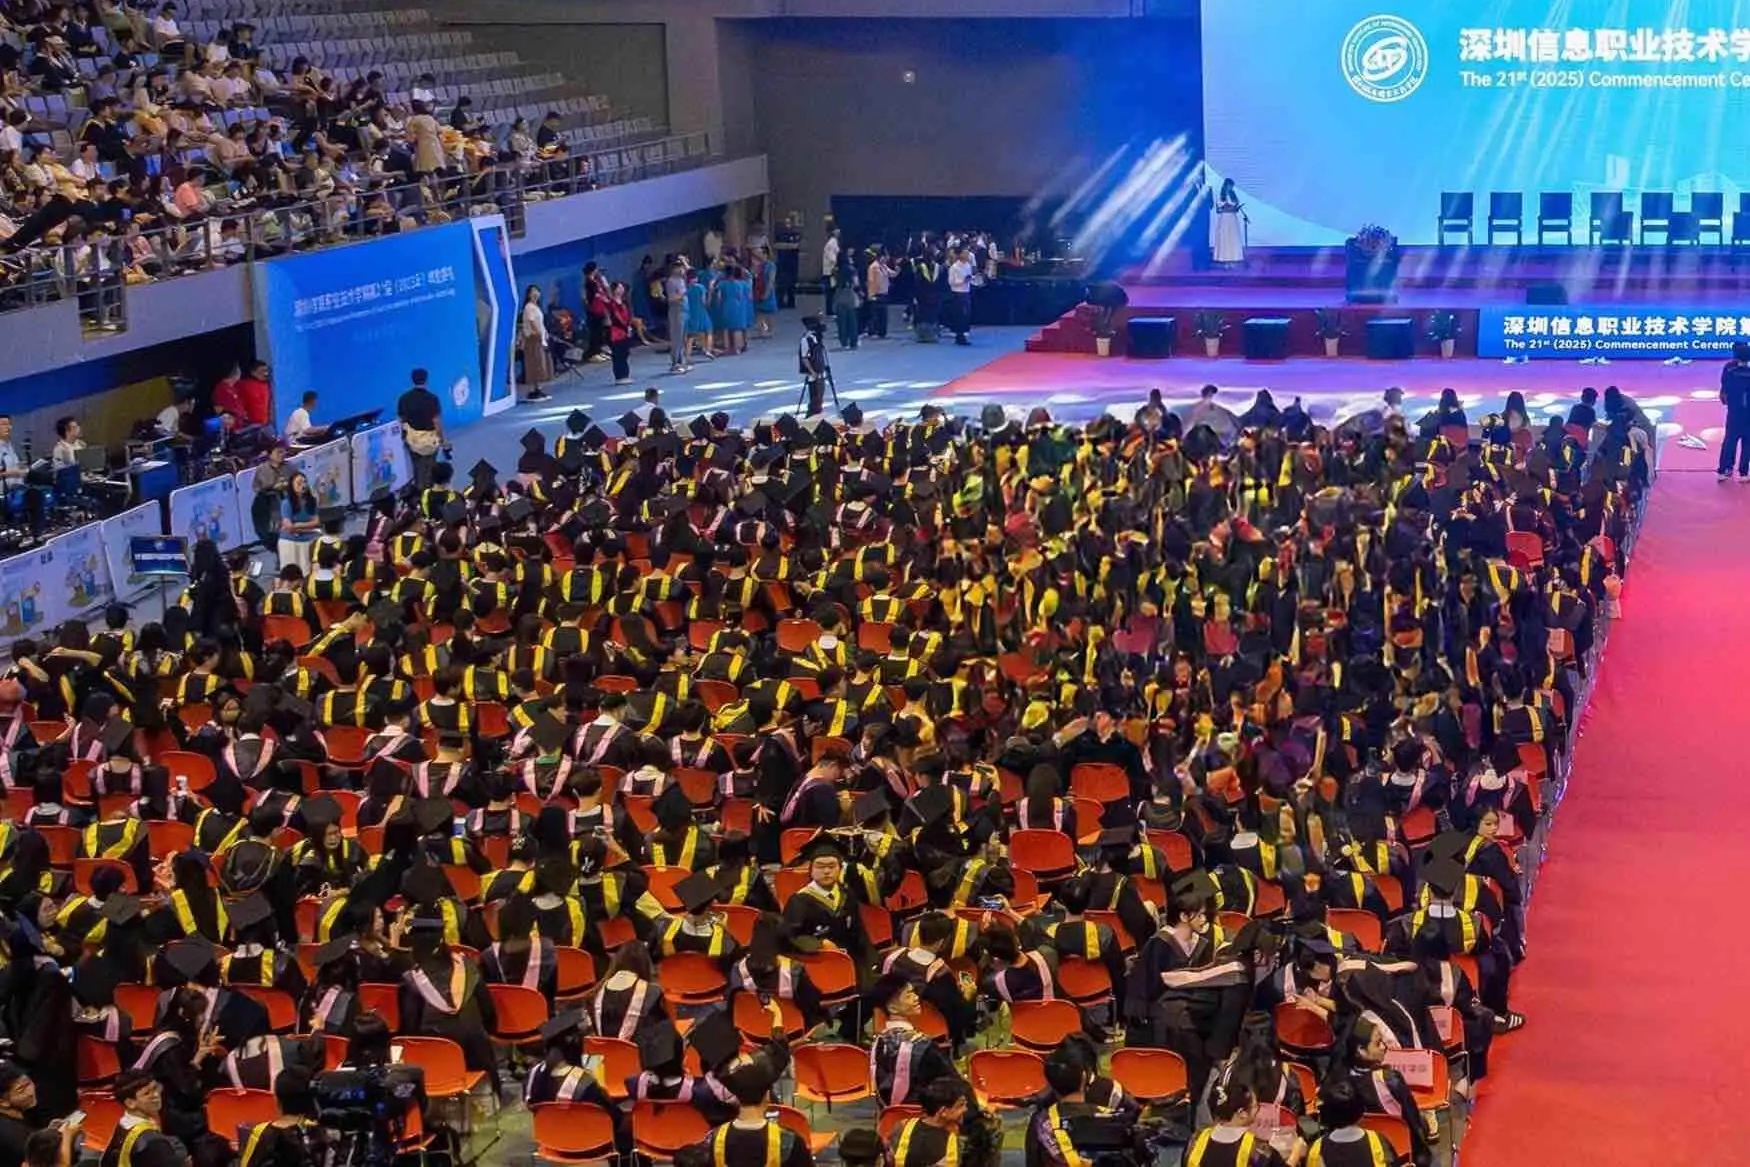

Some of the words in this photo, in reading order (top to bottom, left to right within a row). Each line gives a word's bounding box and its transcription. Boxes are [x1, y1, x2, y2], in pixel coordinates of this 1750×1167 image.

[1460, 70, 1492, 87] The
[1497, 70, 1527, 87] 21st
[1530, 70, 1585, 90] (2025)
[1590, 70, 1726, 87] Commencement
[1504, 339, 1525, 349] The
[1553, 338, 1592, 350] (2025)
[1595, 339, 1689, 350] Commencement
